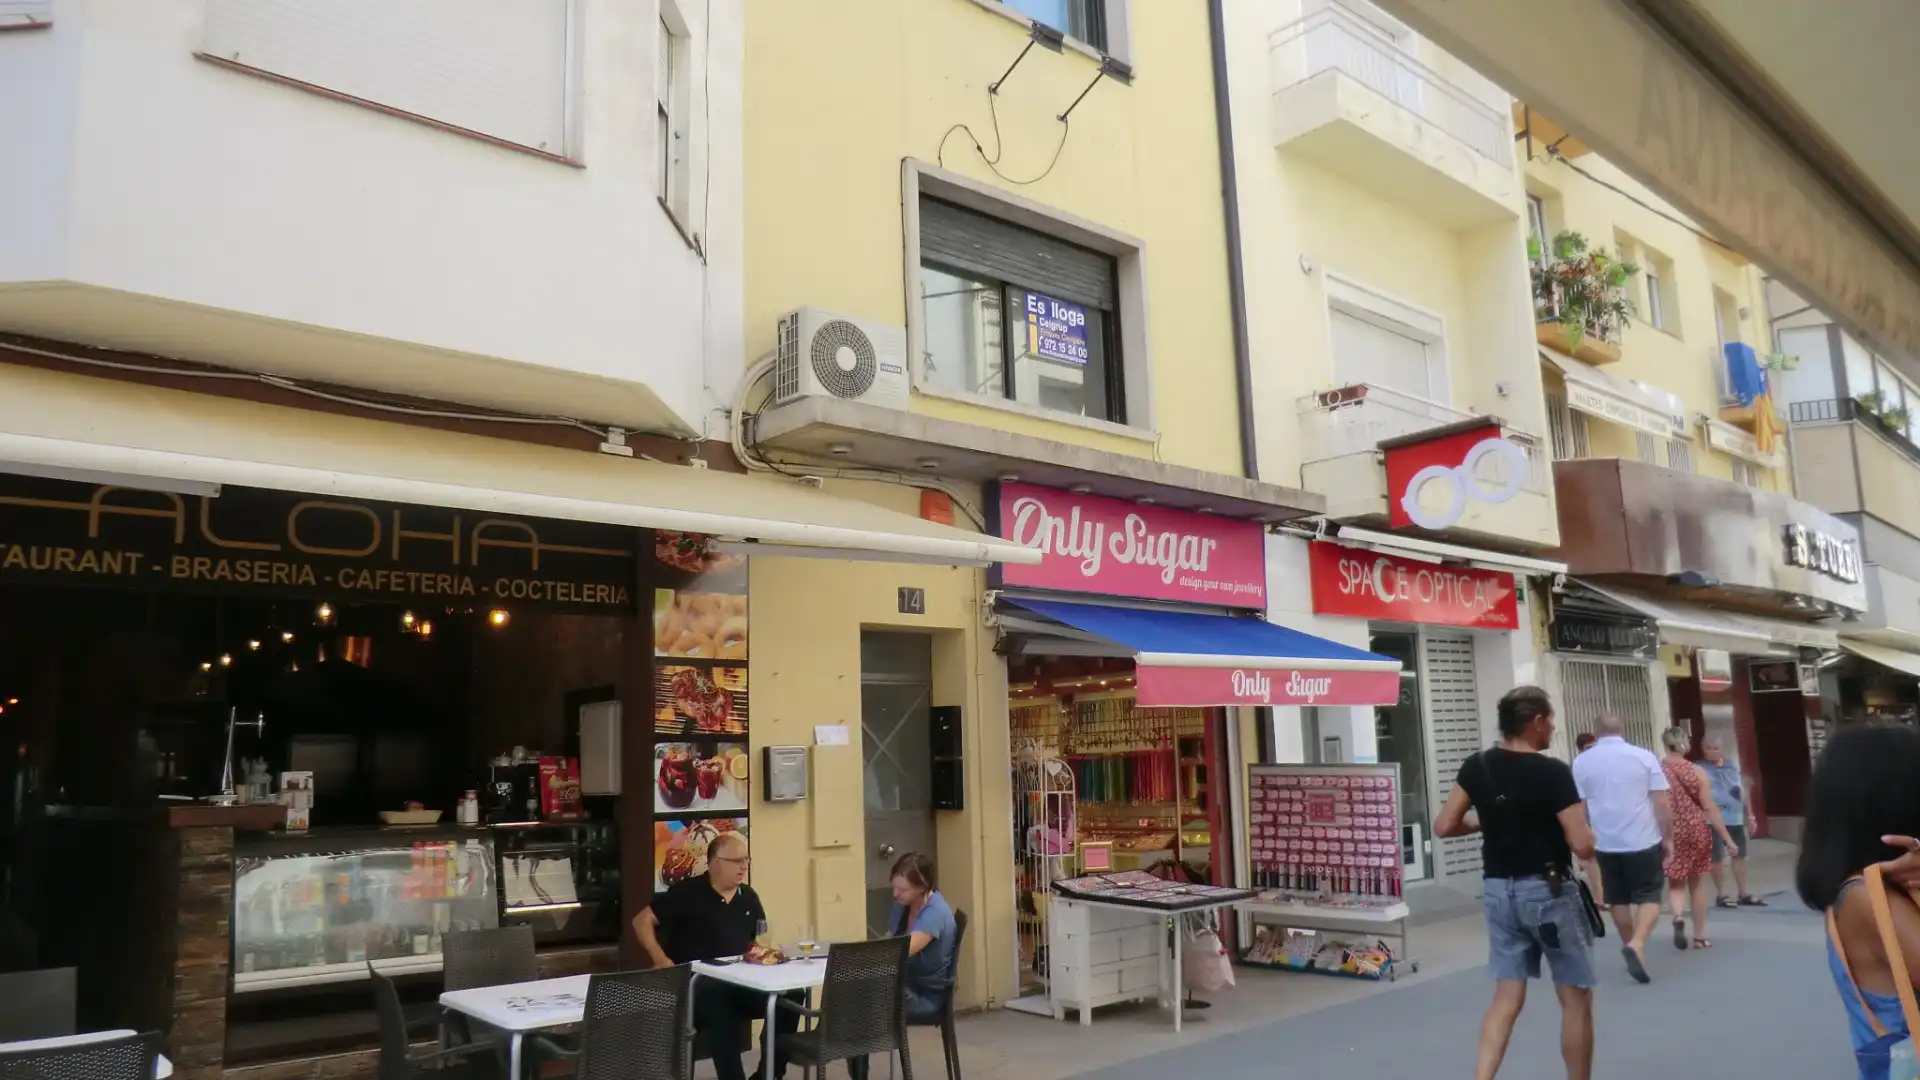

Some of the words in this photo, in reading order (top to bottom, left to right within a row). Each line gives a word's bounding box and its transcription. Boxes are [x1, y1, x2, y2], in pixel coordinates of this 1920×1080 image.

[1027, 294, 1045, 315] Es
[1051, 301, 1085, 327] lloga
[1044, 338, 1056, 351] 972
[1058, 342, 1066, 353] 15
[1078, 347, 1087, 359] 00
[88, 484, 540, 571] ALOHA
[1012, 496, 1104, 577] Only
[1109, 513, 1217, 585] Sugar
[0, 543, 144, 576] AURANT
[171, 555, 317, 586] BRASERIA
[338, 567, 475, 597] CAFETERIA
[494, 577, 629, 605] COCTELERIA
[1179, 576, 1203, 591] design
[1203, 579, 1219, 592] your
[1338, 556, 1410, 604] SPACE
[1415, 568, 1496, 611] OPTICAL
[901, 588, 921, 612] 14
[1231, 669, 1271, 704] Only
[1285, 670, 1332, 704] Sugar
